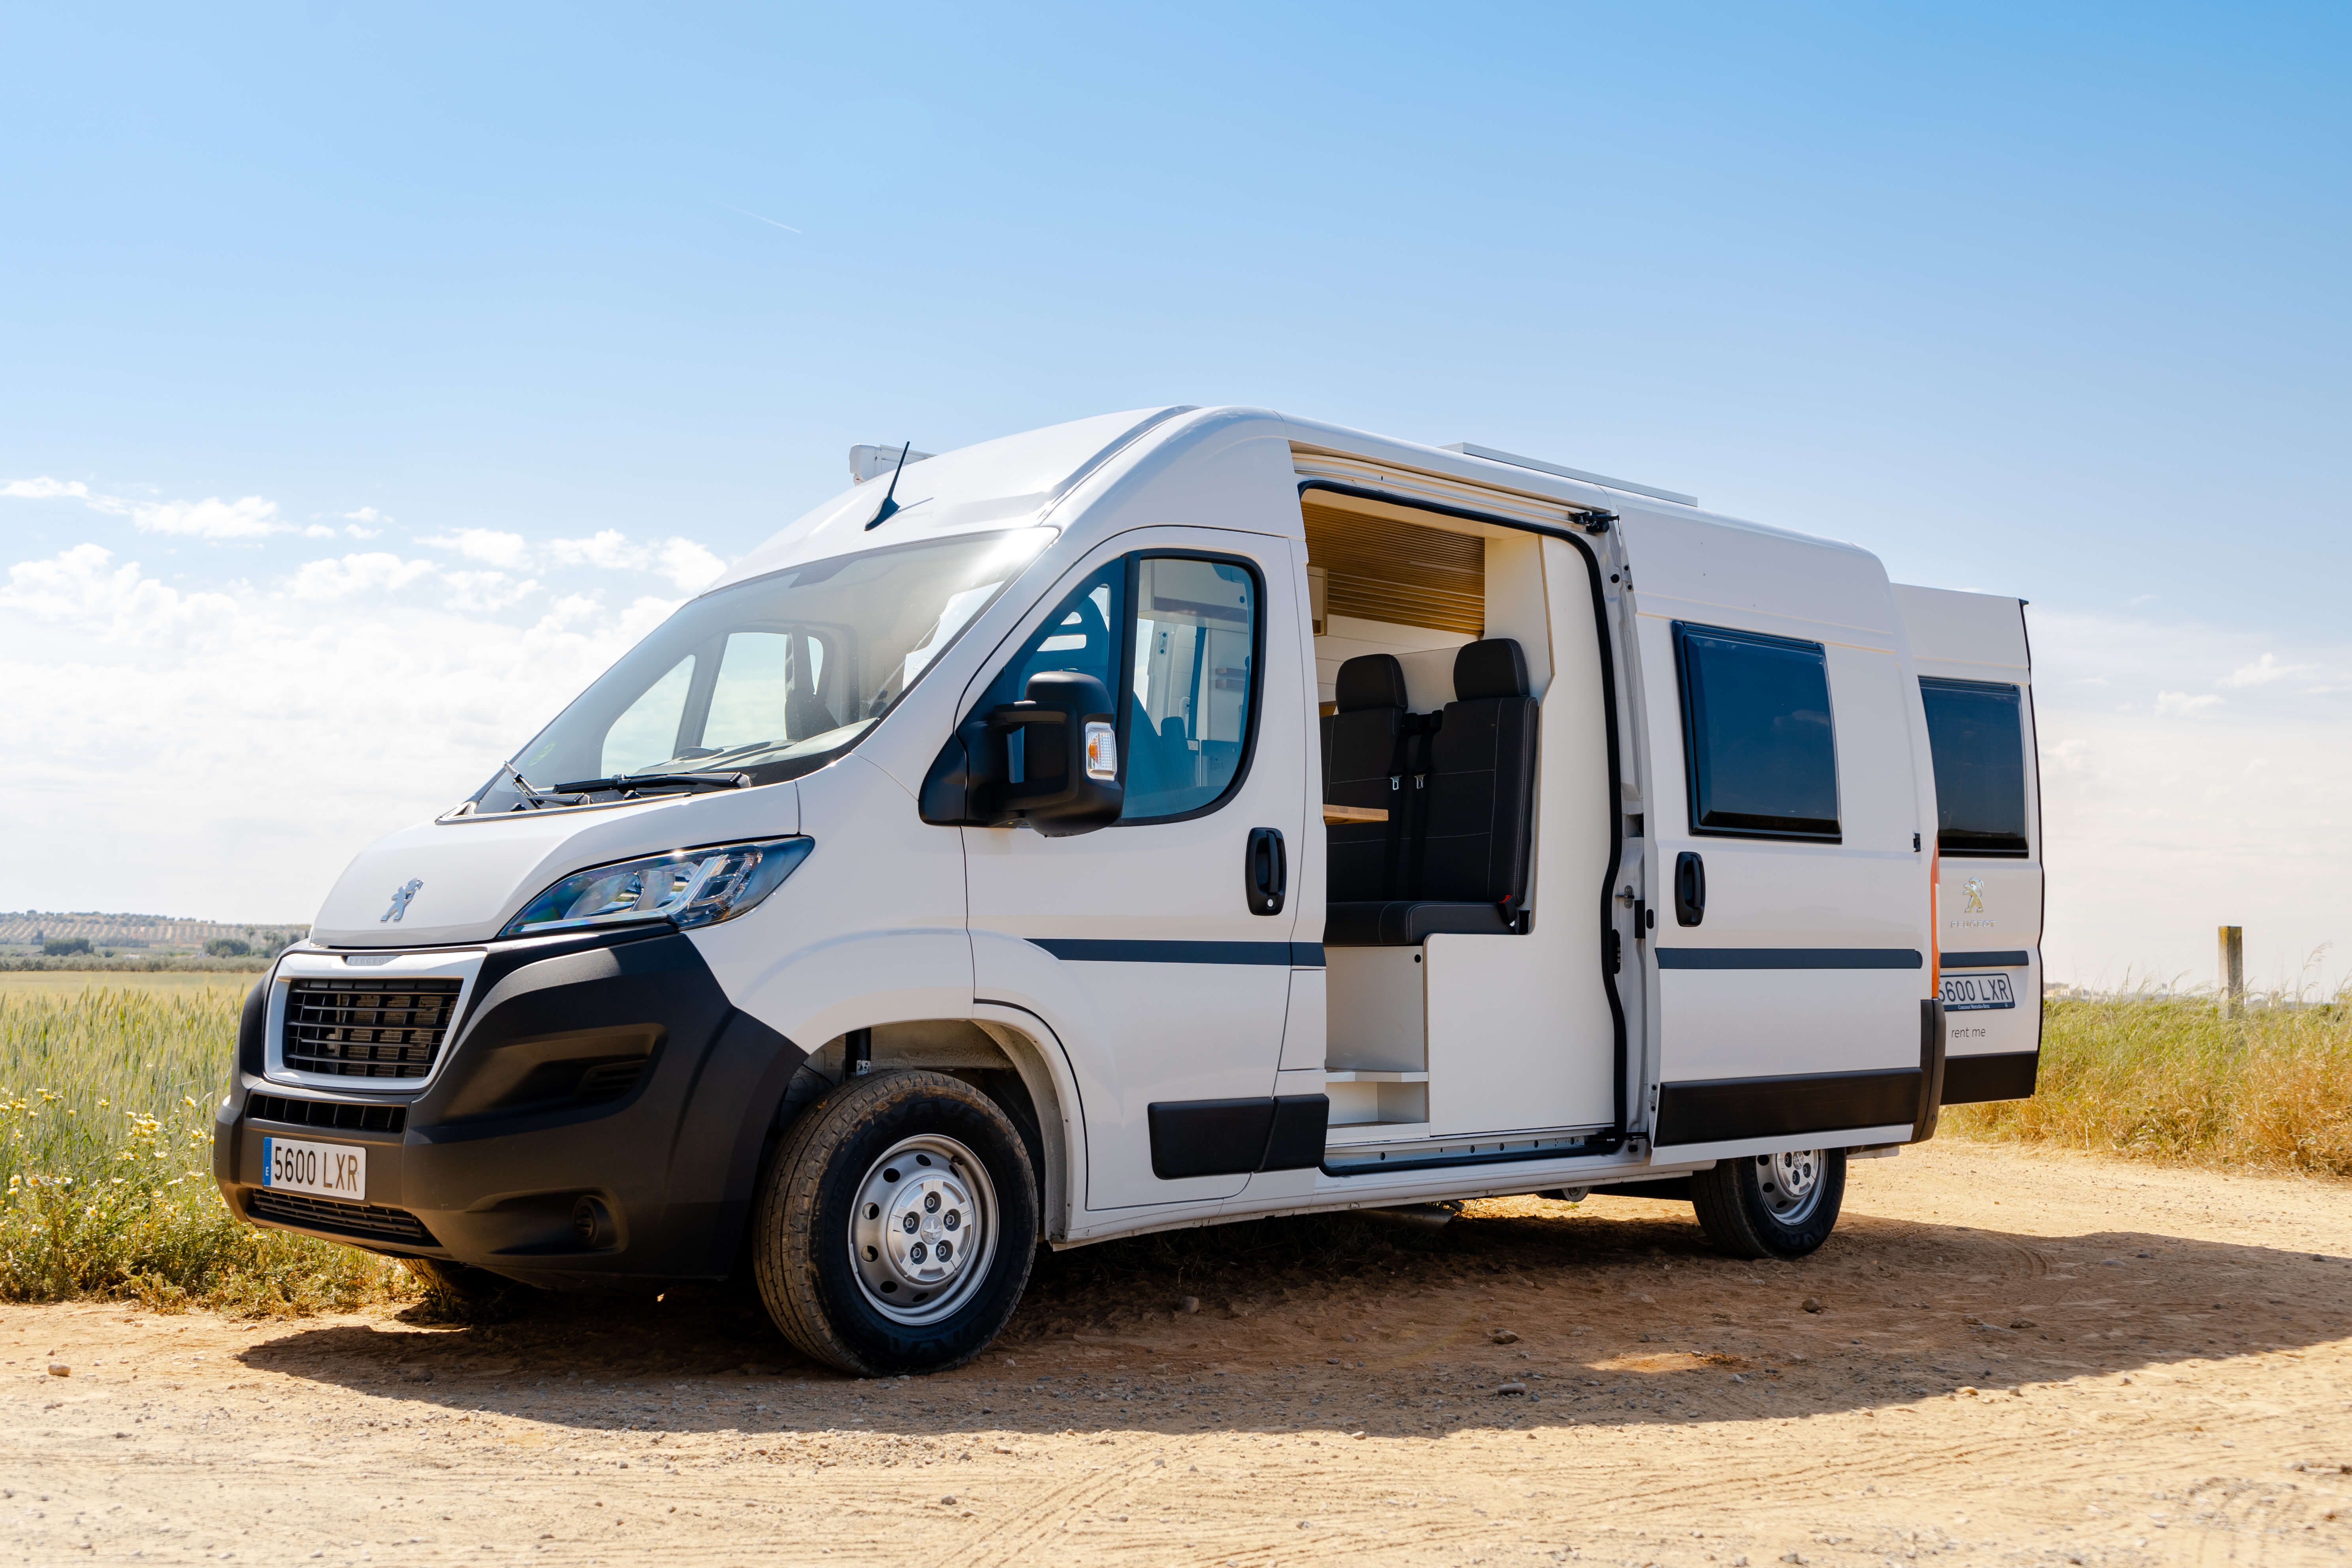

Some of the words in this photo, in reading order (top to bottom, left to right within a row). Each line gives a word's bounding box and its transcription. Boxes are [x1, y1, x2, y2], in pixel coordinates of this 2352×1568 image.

[1951, 920, 1997, 928] PEUGEOT
[1978, 979, 2009, 1001] LXR
[1951, 1027, 1969, 1038] rent
[1972, 1028, 1985, 1037] me
[266, 1166, 269, 1176] E
[274, 1146, 316, 1186] 5600
[323, 1152, 358, 1192] LXR
